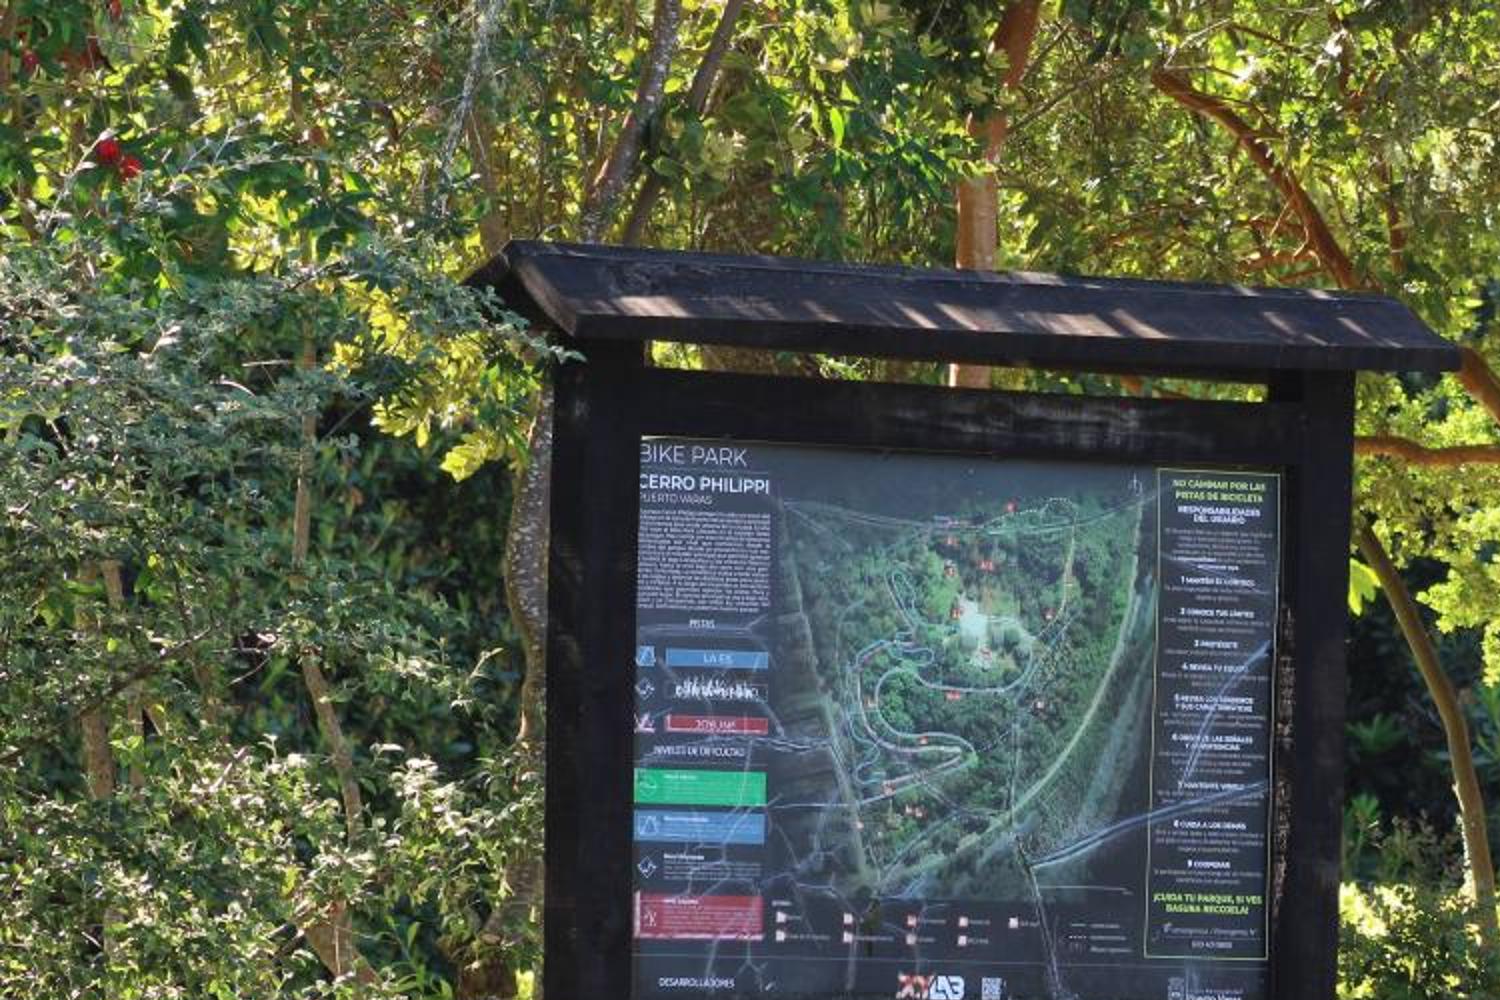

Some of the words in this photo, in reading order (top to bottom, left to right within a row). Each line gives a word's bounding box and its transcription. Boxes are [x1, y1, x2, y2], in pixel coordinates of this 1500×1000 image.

[640, 443, 685, 465] BIKE
[691, 445, 748, 467] PARK
[640, 473, 695, 491] CERRO
[700, 476, 769, 495] PHILIPPI
[1172, 479, 1186, 488] NO
[1230, 481, 1248, 491] POR
[1250, 482, 1265, 492] LAS
[679, 493, 713, 506] VARAS
[1175, 490, 1205, 501] PISTAS
[1220, 492, 1263, 503] BICICLETA
[1193, 514, 1209, 523] DEL
[1183, 892, 1195, 902] TU
[1245, 895, 1263, 905] VES
